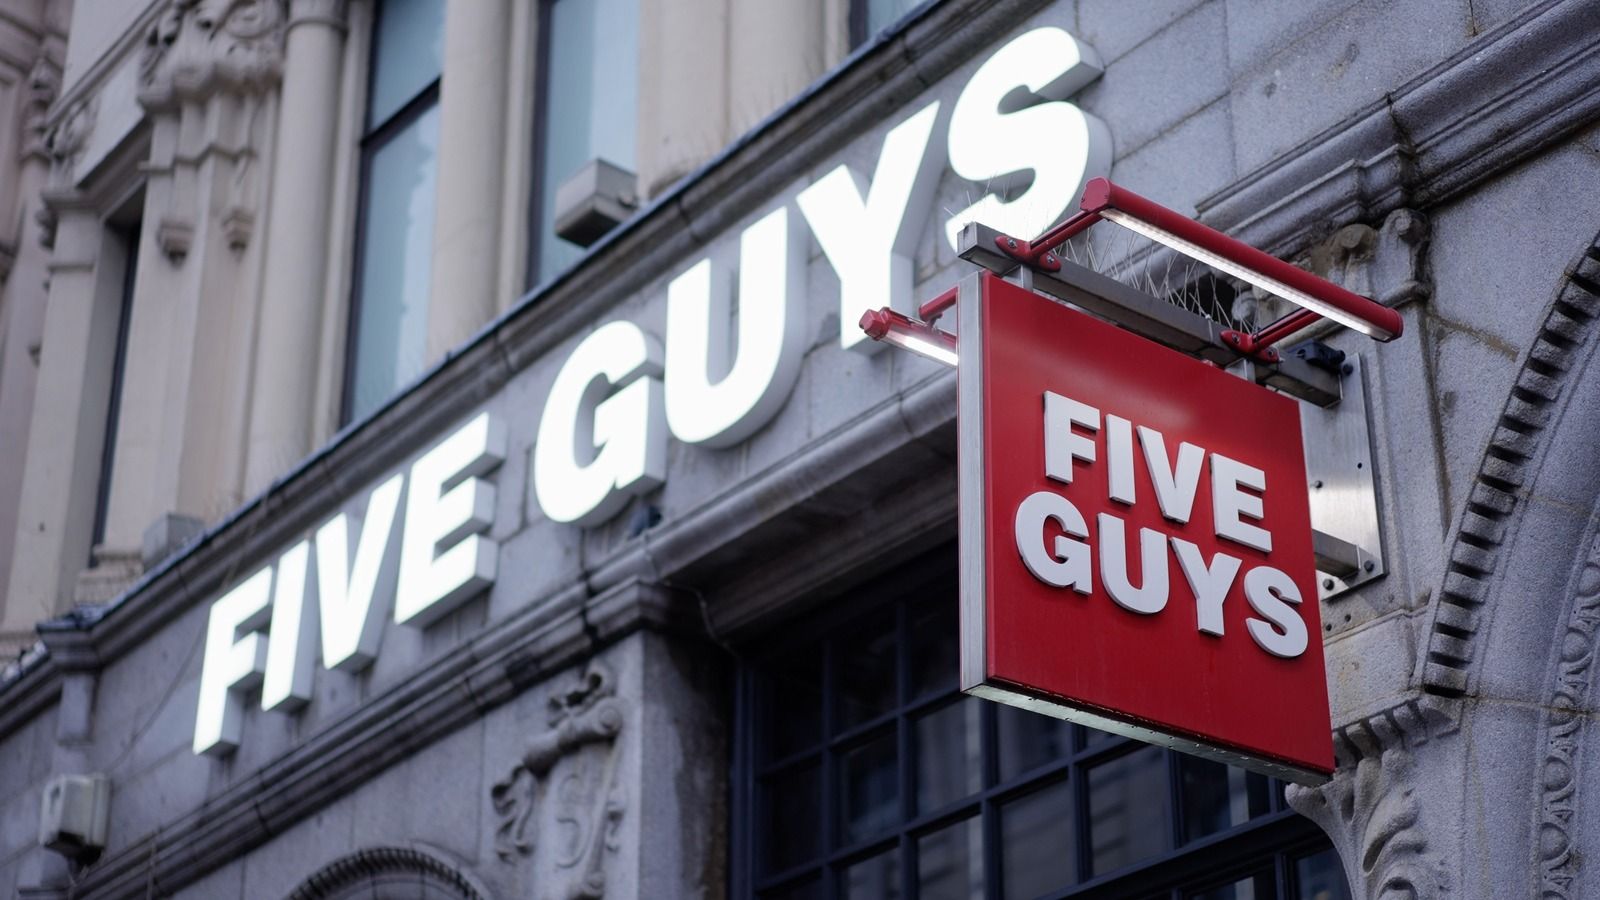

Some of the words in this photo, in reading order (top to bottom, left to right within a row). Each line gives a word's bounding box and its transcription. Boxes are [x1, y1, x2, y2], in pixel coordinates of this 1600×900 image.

[193, 411, 490, 755] FIVE
[534, 26, 1092, 523] GUYS
[1043, 390, 1273, 553] FIVE
[1014, 491, 1309, 659] GUYS
